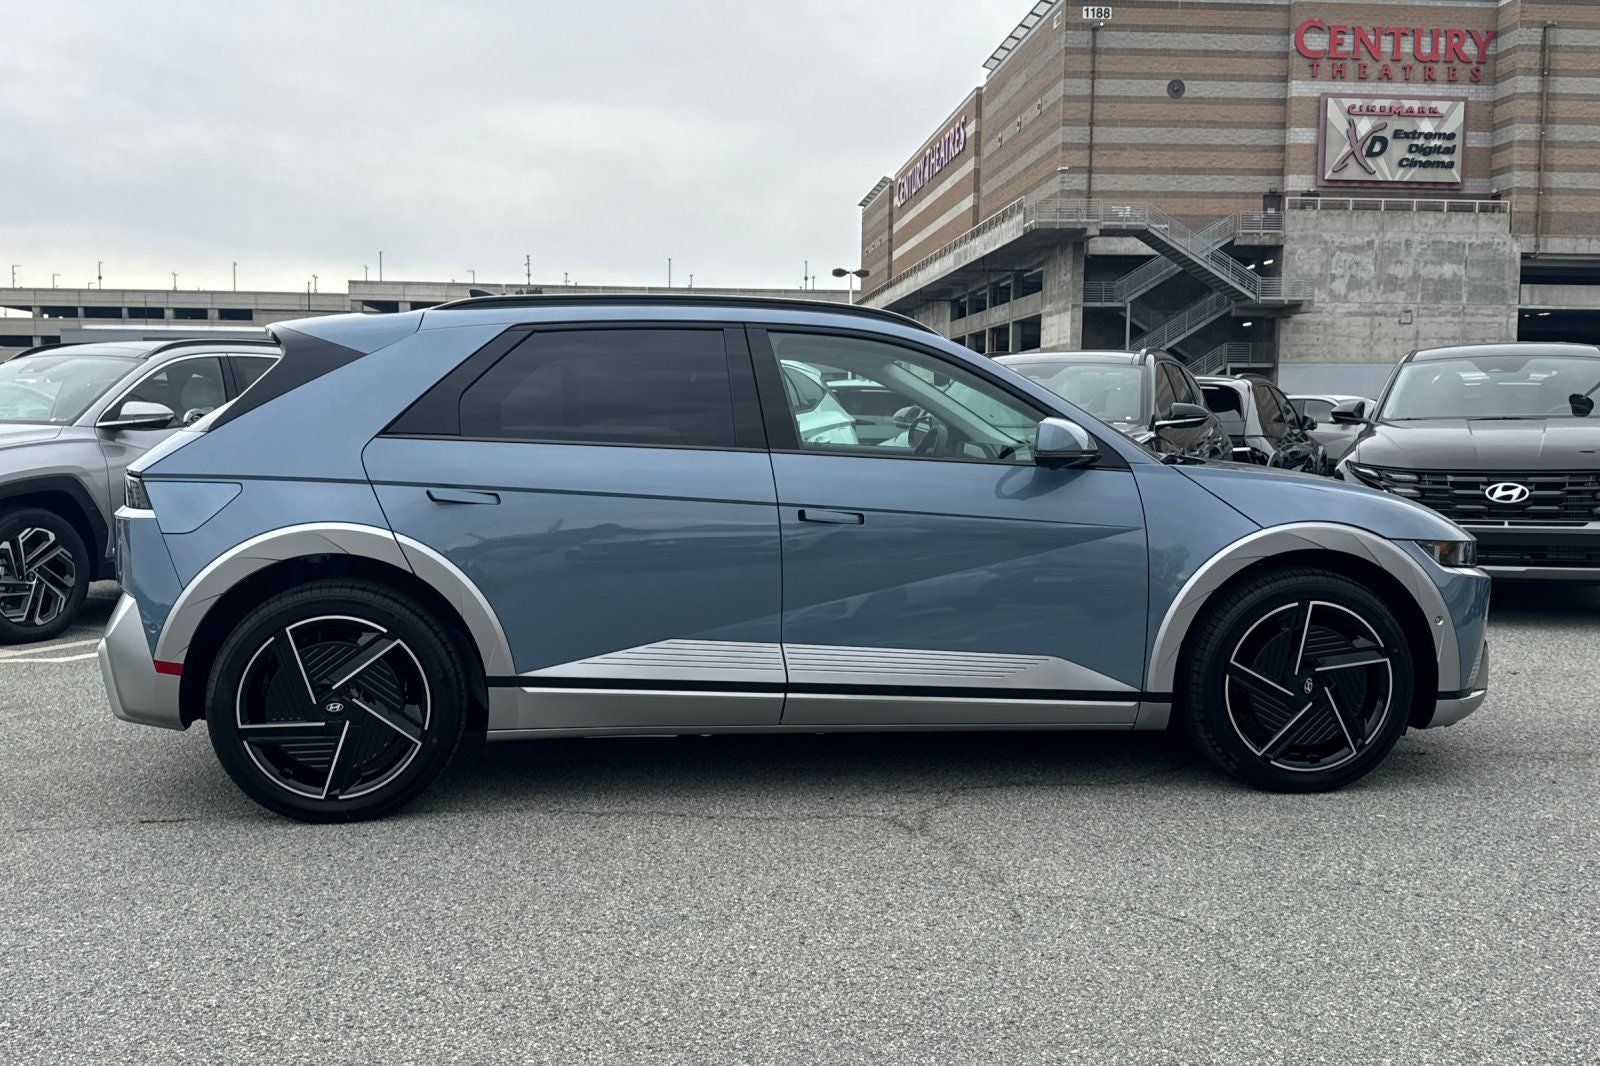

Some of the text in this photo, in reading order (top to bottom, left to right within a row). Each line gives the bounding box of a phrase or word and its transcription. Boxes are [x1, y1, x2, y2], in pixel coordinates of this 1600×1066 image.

[1084, 7, 1110, 18] 1188
[1295, 19, 1496, 63] CENTURY
[1309, 63, 1482, 82] THEATRES
[1348, 104, 1443, 117] CINEMARK
[1392, 129, 1456, 141] Extreme
[1407, 143, 1456, 156] Digital
[896, 115, 967, 208] CENTURY THEATRES
[1398, 157, 1455, 169] Cinema
